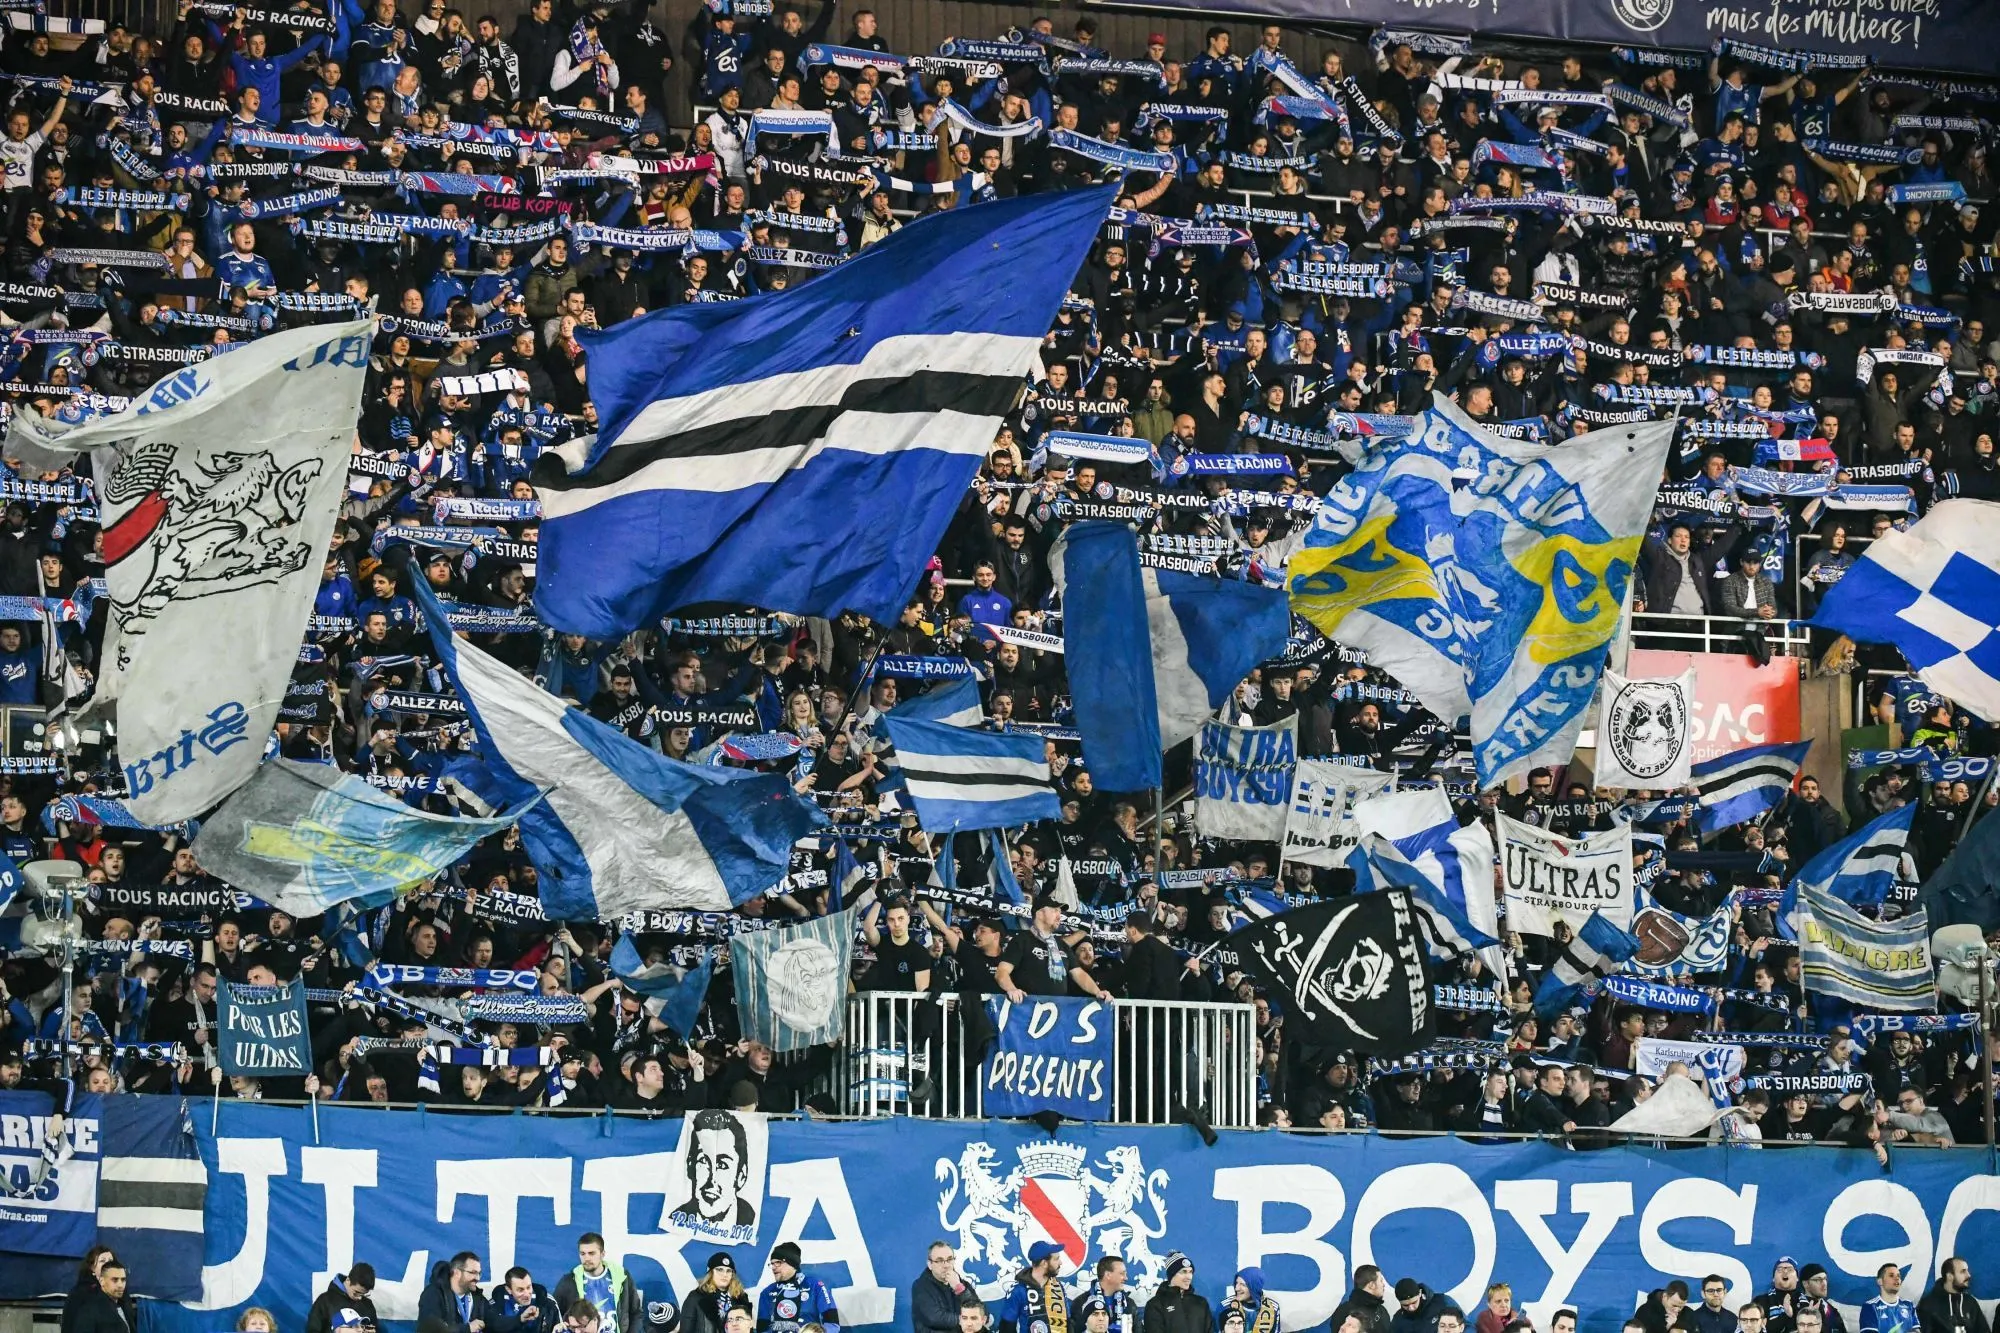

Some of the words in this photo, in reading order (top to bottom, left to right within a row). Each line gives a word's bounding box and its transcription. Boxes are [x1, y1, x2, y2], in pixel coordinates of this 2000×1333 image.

[269, 11, 325, 29] RACING
[1706, 6, 1759, 33] mais
[1765, 3, 1800, 44] des
[1805, 8, 1911, 44] Milliers
[967, 46, 1003, 56] ALLEZ
[1007, 47, 1039, 58] RACING
[1637, 51, 1690, 66] STRASBOURG
[1731, 46, 1783, 68] STRASBOURG
[1809, 53, 1867, 64] STRASBOURG
[1060, 58, 1089, 71] Racing
[1090, 58, 1110, 69] Club
[1112, 59, 1123, 69] de
[1785, 56, 1797, 70] RC
[1547, 92, 1606, 103] POPULAIRE
[1611, 88, 1632, 104] ALLEZ
[1631, 93, 1677, 121] STRASBOURG
[1150, 102, 1183, 115] Allez
[1347, 83, 1401, 142] STRASBOURG
[623, 117, 637, 130] RC
[1897, 118, 1924, 128] RACING
[1925, 118, 1942, 129] CLUB
[252, 129, 300, 147] ACADEMY
[303, 134, 340, 149] RACING
[899, 133, 912, 145] RC
[1829, 142, 1859, 152] ALLEZ
[1861, 146, 1898, 159] RACING
[1231, 155, 1246, 165] RC
[1248, 154, 1305, 166] STRASBOURG
[211, 164, 224, 177] RC
[226, 163, 289, 177] STRASBOURG
[345, 169, 392, 182] Racing
[772, 160, 809, 179] TOUS
[81, 190, 94, 202] RC
[98, 191, 165, 204] STRASBOURG
[264, 196, 298, 212] ALLEZ
[300, 186, 340, 206] RACING
[1905, 190, 1929, 200] RACING
[1930, 189, 1954, 199] ALLEZ
[484, 194, 521, 211] CLUB
[1216, 203, 1232, 214] RC
[1235, 206, 1297, 220] STRASBOURG
[369, 213, 409, 227] ALLEZ
[769, 211, 836, 229] STRASBOURG
[1596, 214, 1632, 230] TOUS
[312, 220, 326, 232] RC
[329, 221, 398, 237] STRASBOURG
[496, 221, 555, 239] STRASBOURG
[596, 227, 643, 245] ALLEZ
[645, 228, 690, 248] RACING
[750, 247, 788, 261] ALLEZ
[1303, 262, 1316, 272] RC
[1318, 262, 1380, 274] STRASBOURG
[1288, 274, 1301, 285] RC
[1303, 276, 1364, 291] STRASBOURG
[8, 283, 57, 299] RACING
[1543, 284, 1576, 302] TOUS
[285, 295, 354, 305] STRASBOURG
[1468, 289, 1543, 320] Racing
[1903, 313, 1923, 323] SEUL
[1923, 315, 1952, 323] AMOUR
[1499, 337, 1537, 351] ALLEZ
[103, 345, 119, 358] RC
[123, 347, 205, 362] STRASBOURG
[1588, 341, 1621, 357] TOUS
[1625, 350, 1671, 365] RACING
[1716, 350, 1733, 360] RC
[1734, 350, 1795, 363] STRASBOURG
[6, 383, 30, 393] SEUL
[1621, 387, 1636, 396] RC
[1637, 387, 1694, 400] STRASBOURG
[1037, 398, 1074, 411] TOUS
[1568, 405, 1582, 418] RC
[1583, 408, 1649, 424] STRASBOURG
[1271, 423, 1284, 435] RC
[1705, 422, 1768, 434] STRASBOURG
[1053, 437, 1081, 448] RACING
[1081, 440, 1099, 450] CLUB
[1099, 442, 1147, 455] STRASBOURG
[1194, 457, 1232, 470] ALLEZ
[1235, 457, 1282, 470] RACING
[1846, 462, 1922, 479] STRASBOURG
[1750, 475, 1816, 489] STRASBOURG
[1784, 473, 1808, 482] CLUB
[1810, 474, 1825, 483] DE
[2, 481, 75, 496] STRASBOURG
[1115, 487, 1153, 504] TOUS
[1157, 494, 1209, 508] RACING
[1656, 491, 1733, 514] STRASBOURG
[474, 499, 521, 516] Racing
[1057, 502, 1072, 516] RC
[1075, 503, 1156, 518] STRASBOURG
[386, 527, 447, 542] Racing
[1149, 535, 1164, 546] RC
[1167, 537, 1234, 550] STRASBOURG
[478, 539, 494, 554] RC
[701, 617, 767, 629] STRASBOURG
[999, 627, 1060, 645] STRASBOURG
[884, 660, 921, 673] ALLEZ
[390, 696, 434, 710] ALLEZ
[697, 711, 754, 725] RACING
[1202, 727, 1296, 764] ULTRA
[1941, 757, 1989, 778] 90
[1506, 843, 1621, 900] ULTRAS
[106, 888, 151, 904] TOUS
[157, 889, 220, 906] RACING
[928, 887, 993, 909] ULTRA
[1523, 895, 1599, 911] STRASBOURG
[374, 963, 426, 985] UB
[486, 969, 538, 989] 90
[1606, 980, 1647, 997] ALLEZ
[1649, 988, 1700, 1007] RACING
[478, 1000, 518, 1016] Ultra
[523, 1001, 557, 1017] Boys
[564, 1001, 585, 1015] 90
[227, 1005, 265, 1038] POUR
[267, 1009, 301, 1038] LES
[33, 1039, 165, 1061] ULTRAS
[234, 1042, 303, 1069] ULTRAS
[1654, 1046, 1695, 1059] Karlsruher
[987, 1051, 1104, 1102] PRESENTS
[1755, 1076, 1771, 1089] RC
[1775, 1073, 1863, 1091] STRASBOURG
[178, 1137, 896, 1325] ULTRA
[1212, 1163, 1758, 1328] BOYS
[731, 1226, 754, 1241] 2010
